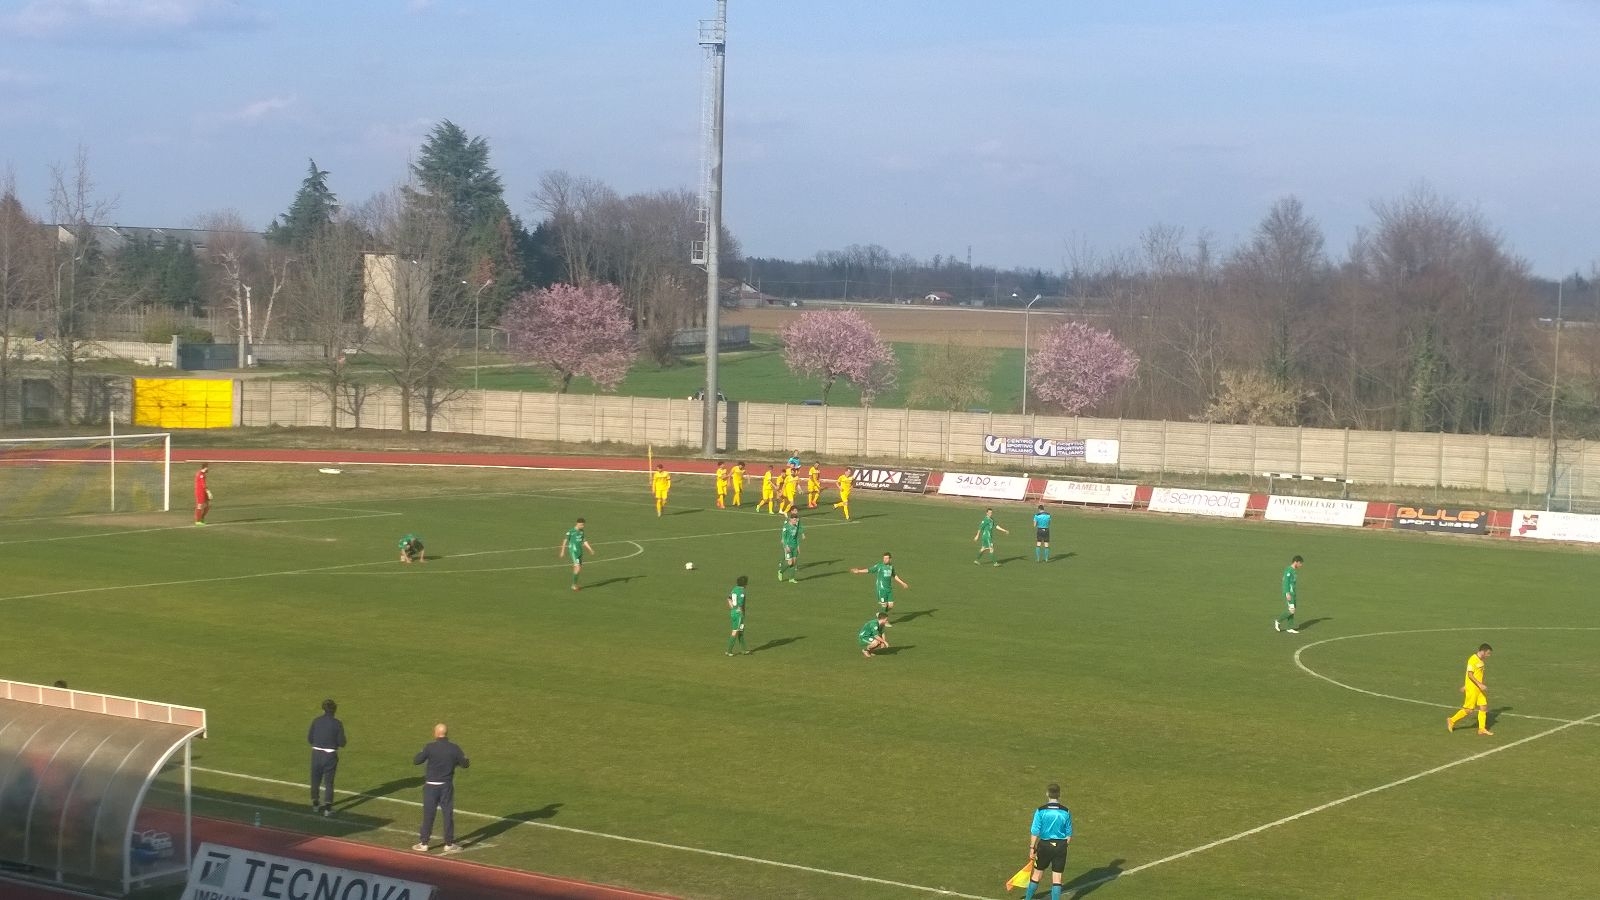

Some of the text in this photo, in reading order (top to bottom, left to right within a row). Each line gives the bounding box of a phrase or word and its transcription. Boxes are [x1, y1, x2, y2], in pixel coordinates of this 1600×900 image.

[852, 469, 902, 484] MIX
[956, 475, 991, 486] SALDO
[1170, 491, 1240, 508] sermedia
